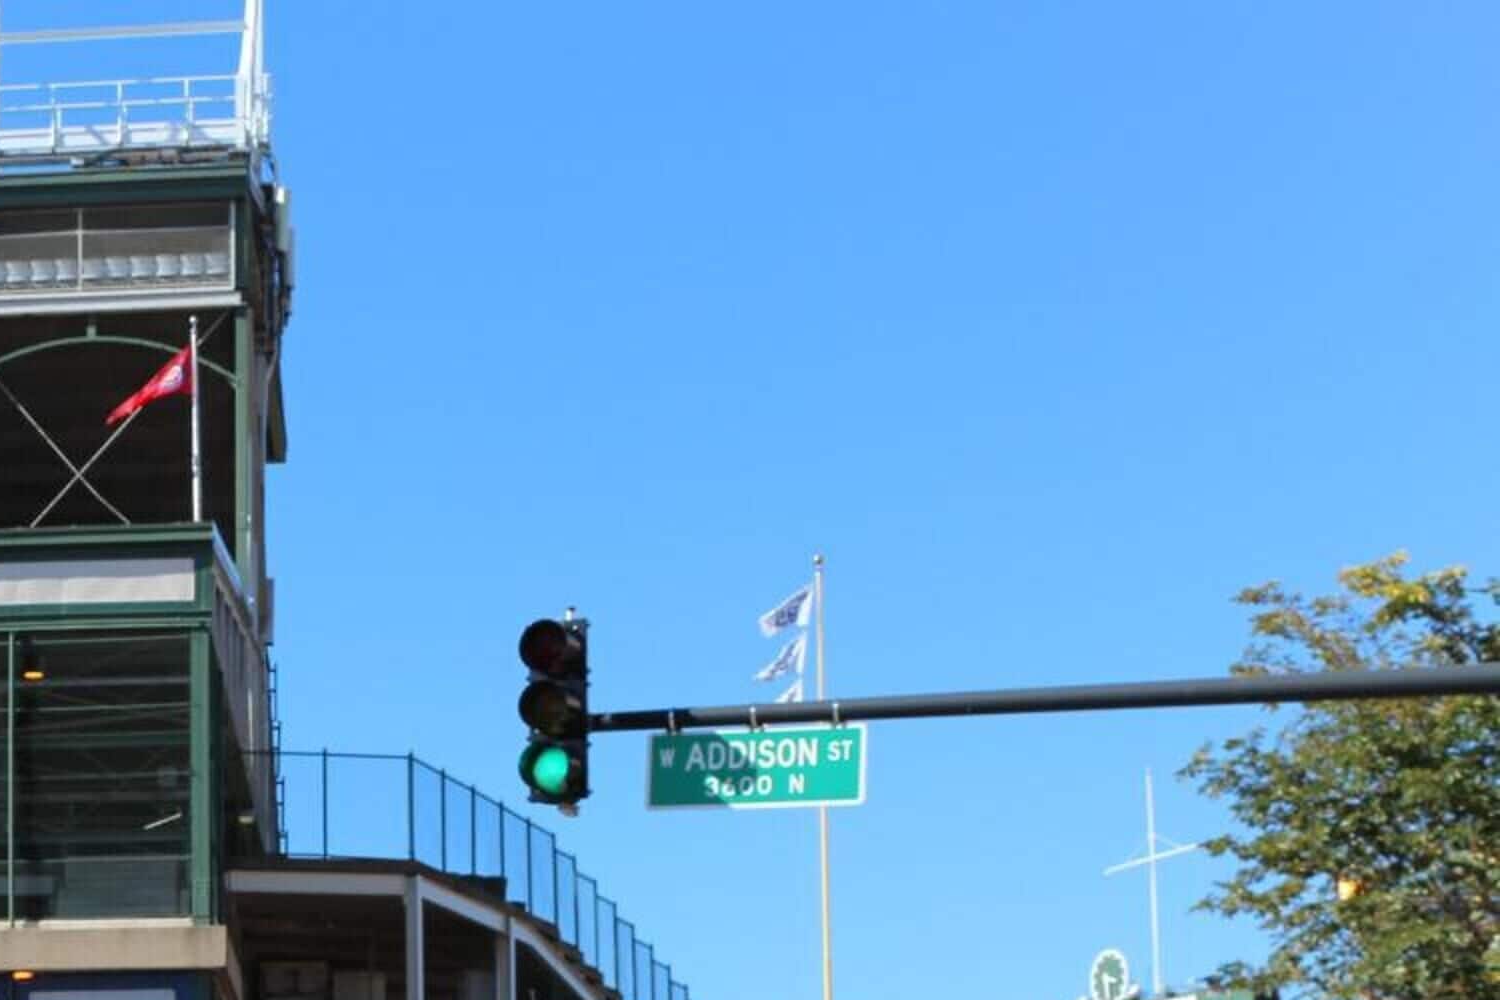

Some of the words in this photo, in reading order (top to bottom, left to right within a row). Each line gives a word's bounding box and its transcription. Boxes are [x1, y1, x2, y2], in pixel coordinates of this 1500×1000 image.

[660, 748, 675, 768] W
[684, 738, 819, 772] ADDISON
[827, 740, 853, 761] ST
[705, 775, 773, 797] 3600
[788, 774, 805, 794] N
